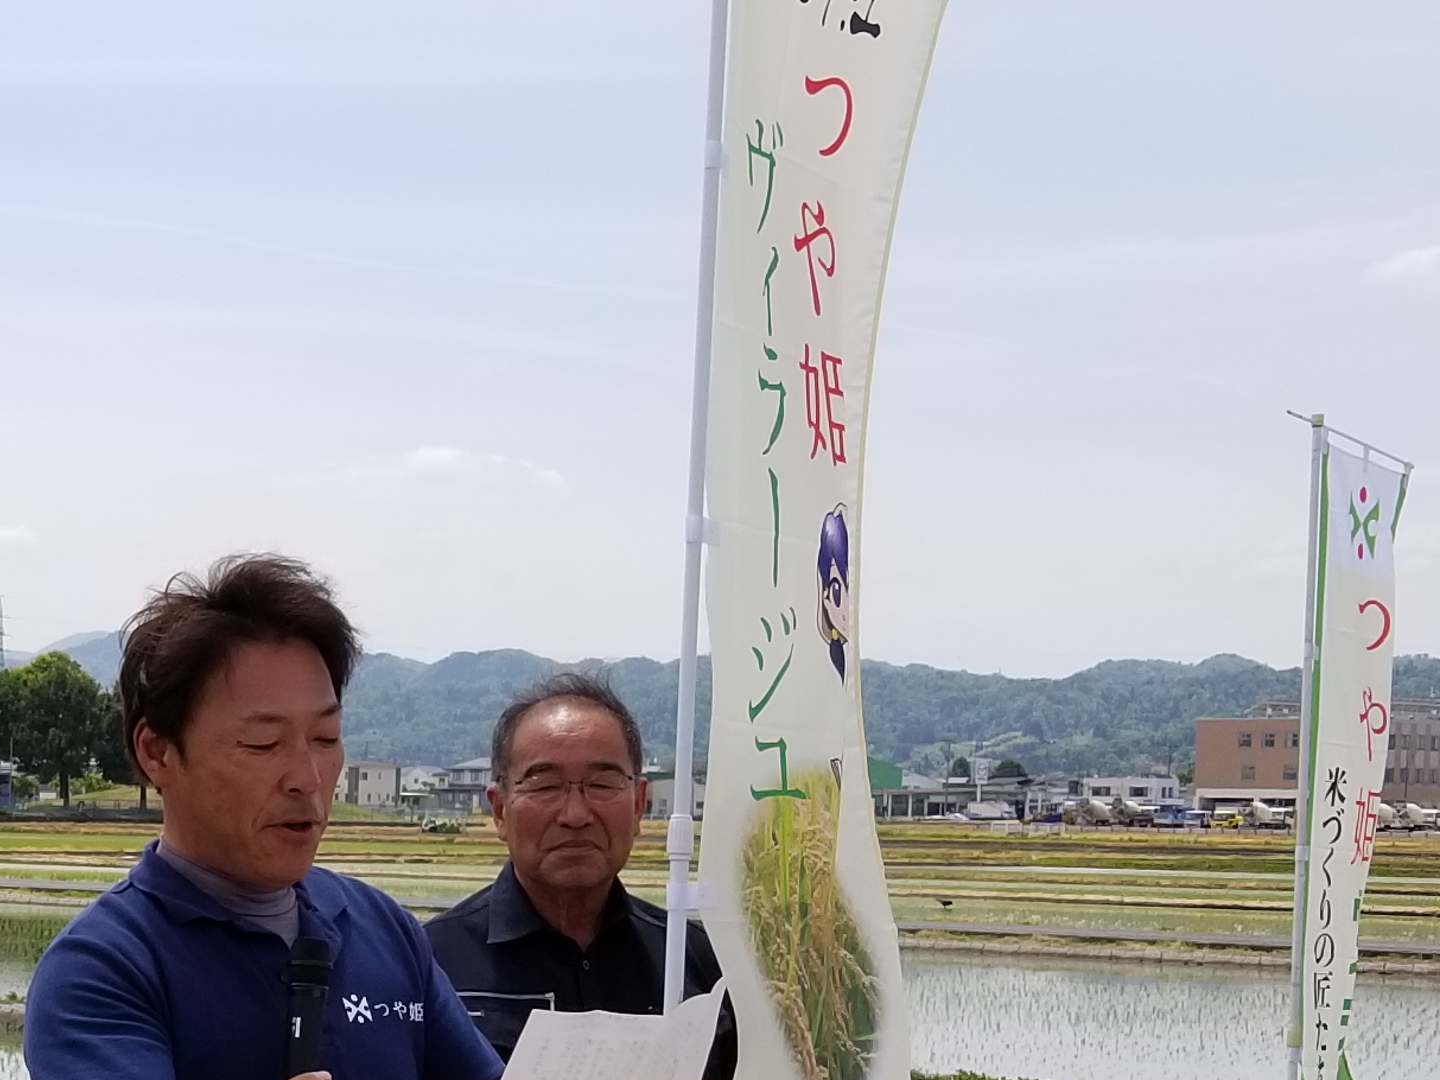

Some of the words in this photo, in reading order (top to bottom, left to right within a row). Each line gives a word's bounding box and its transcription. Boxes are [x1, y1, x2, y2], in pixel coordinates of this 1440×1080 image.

[794, 75, 853, 467] つや姫
[1351, 599, 1391, 866] つや姫
[373, 1000, 424, 1022] つや姫
